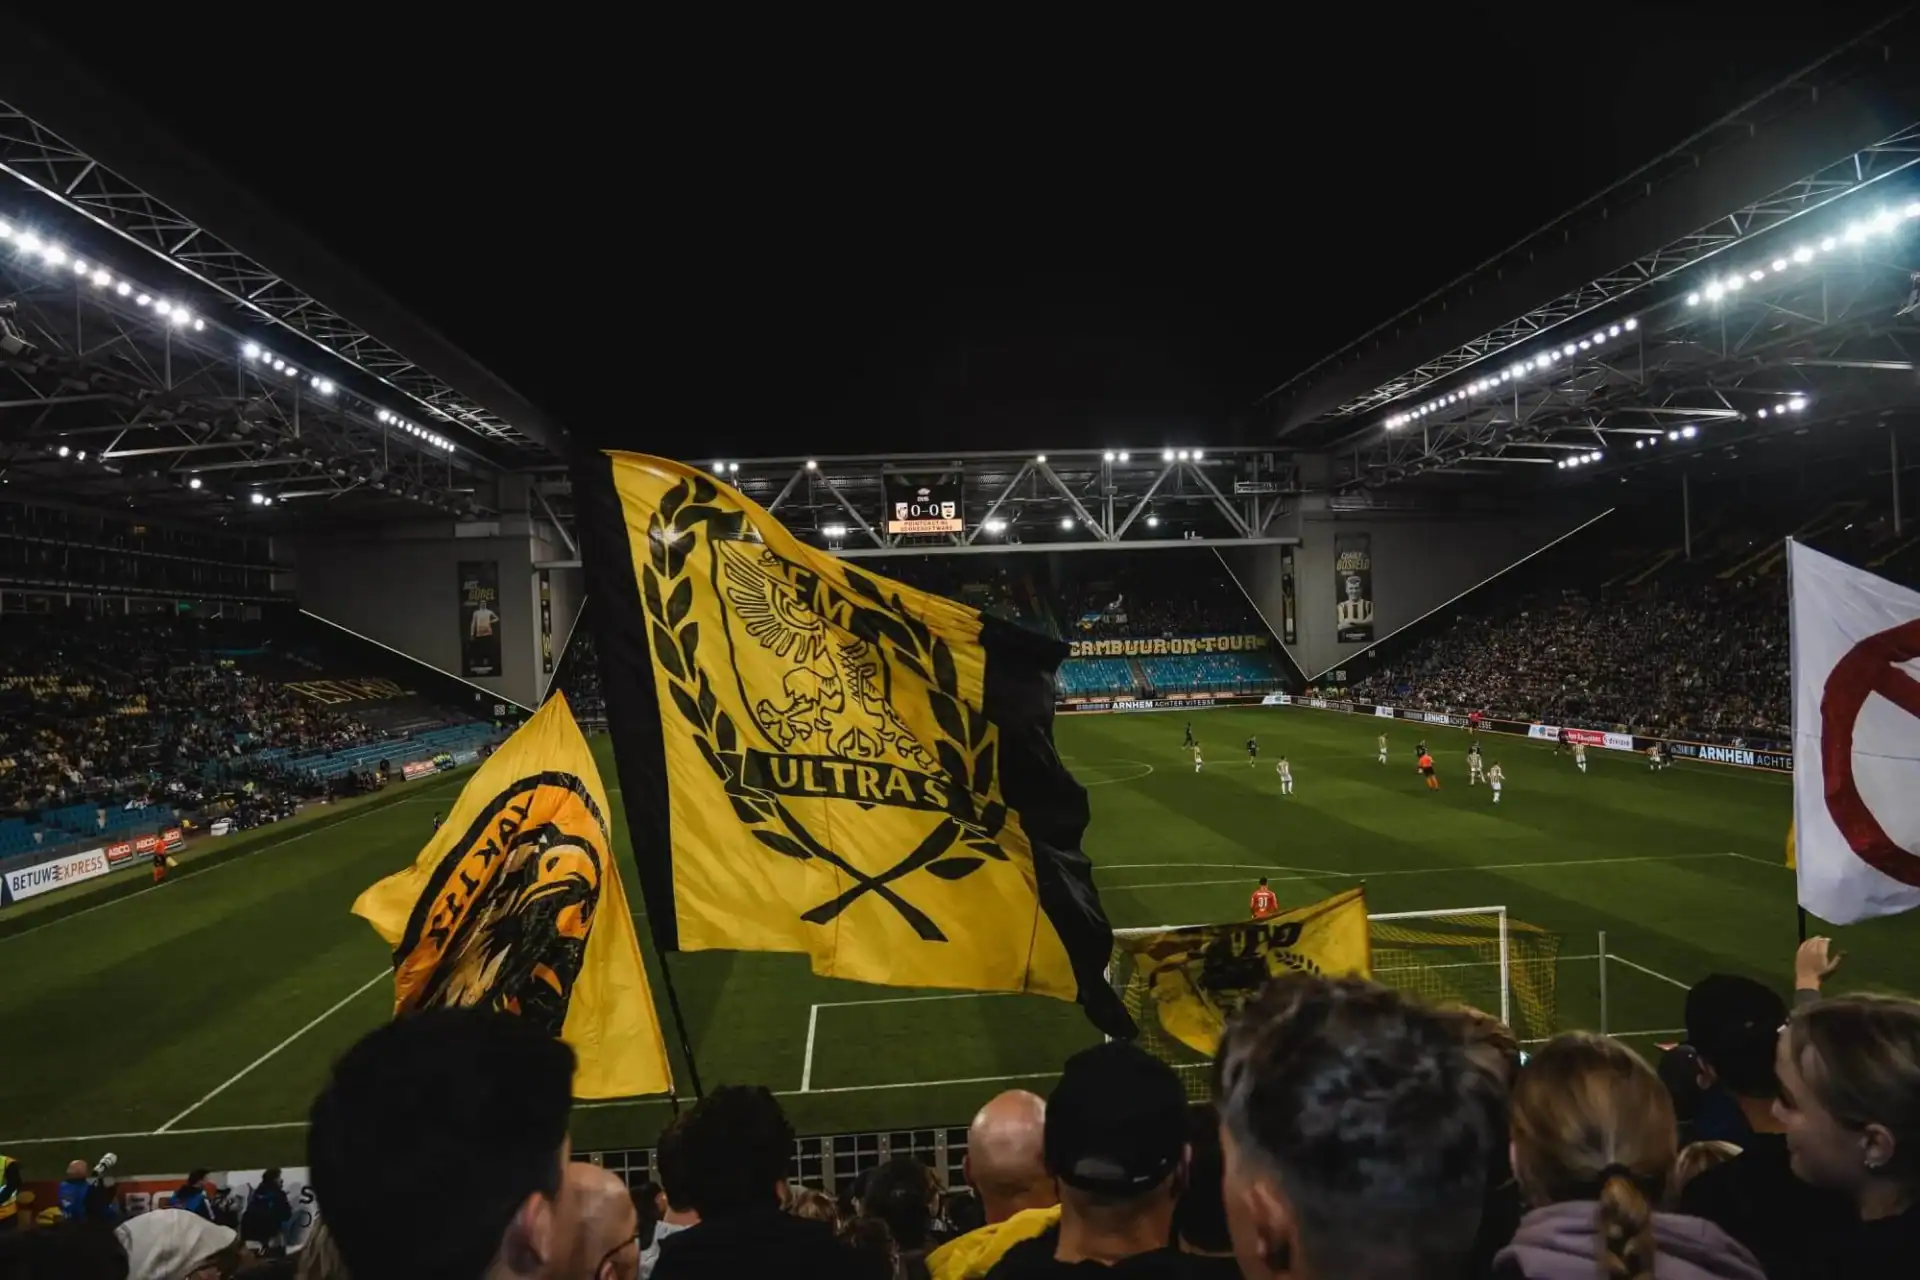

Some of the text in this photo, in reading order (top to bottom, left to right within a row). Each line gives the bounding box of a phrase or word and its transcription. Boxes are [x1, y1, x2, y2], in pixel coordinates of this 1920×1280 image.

[1112, 700, 1153, 710] ARNHEM
[1155, 700, 1183, 708] ACHTER
[1698, 745, 1754, 766] ARNHEM
[770, 757, 949, 808] ULTRAS
